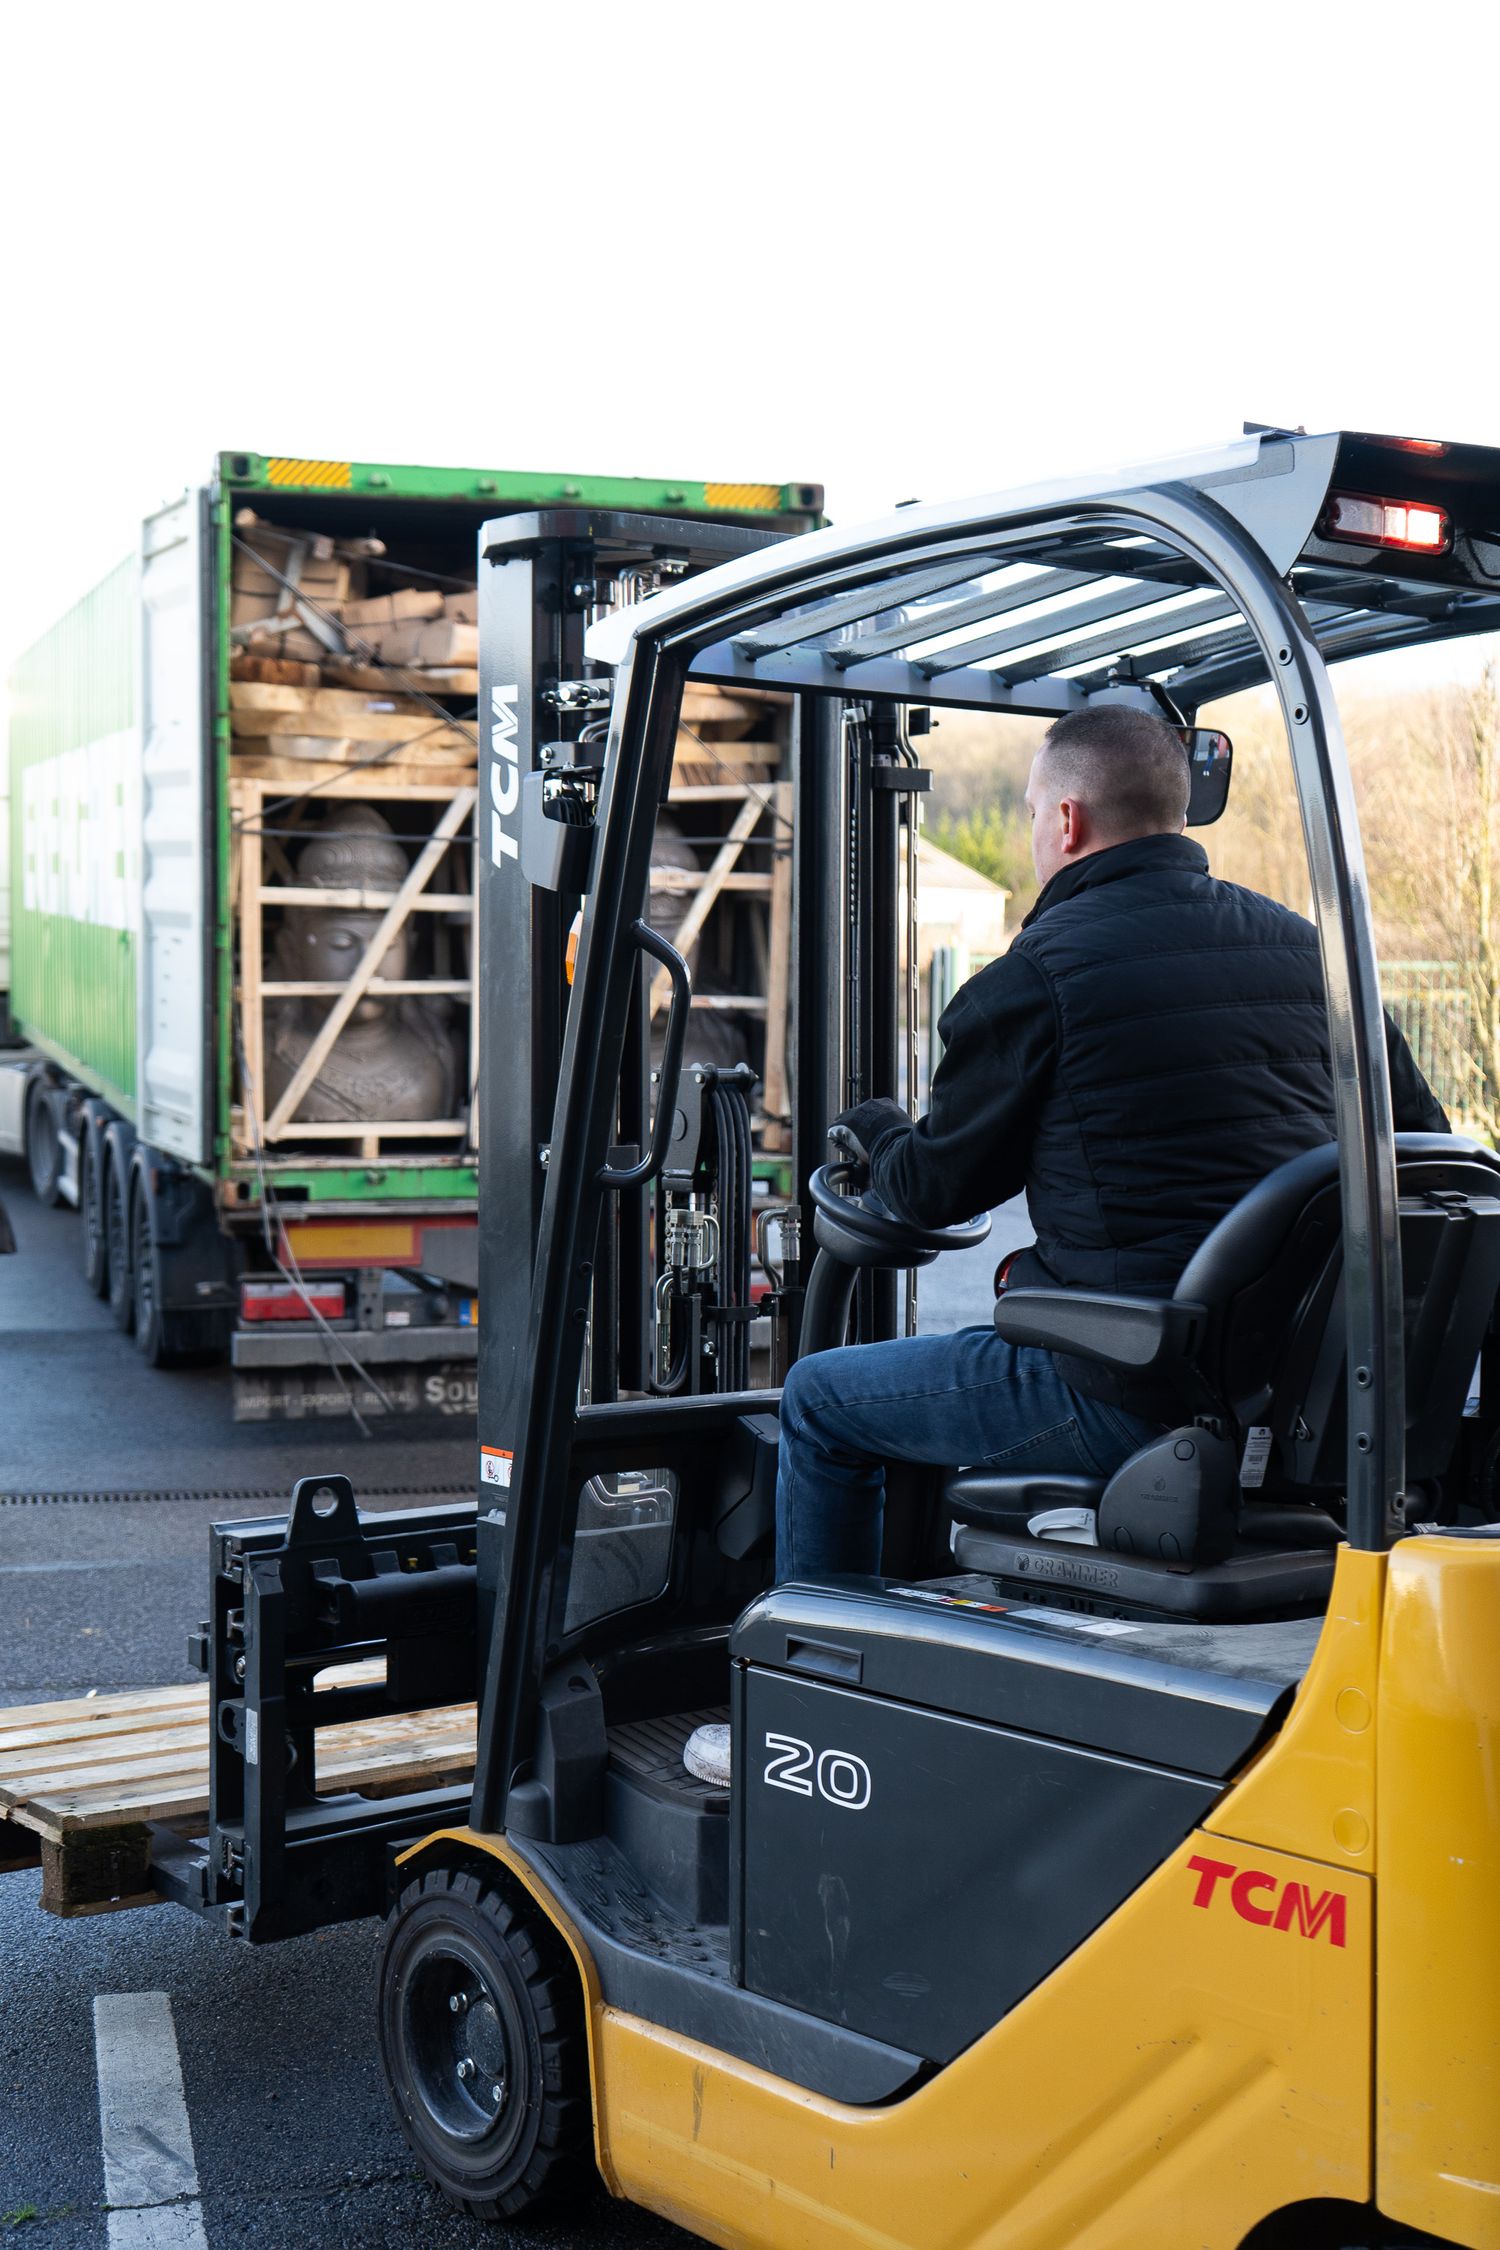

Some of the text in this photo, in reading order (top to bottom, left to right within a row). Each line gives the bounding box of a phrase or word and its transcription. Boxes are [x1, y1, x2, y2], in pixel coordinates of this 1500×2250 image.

[491, 684, 519, 869] TCM
[1034, 1557, 1119, 1587] GRAMMER
[764, 1732, 871, 1810] 20
[1186, 1854, 1347, 1948] TCM
